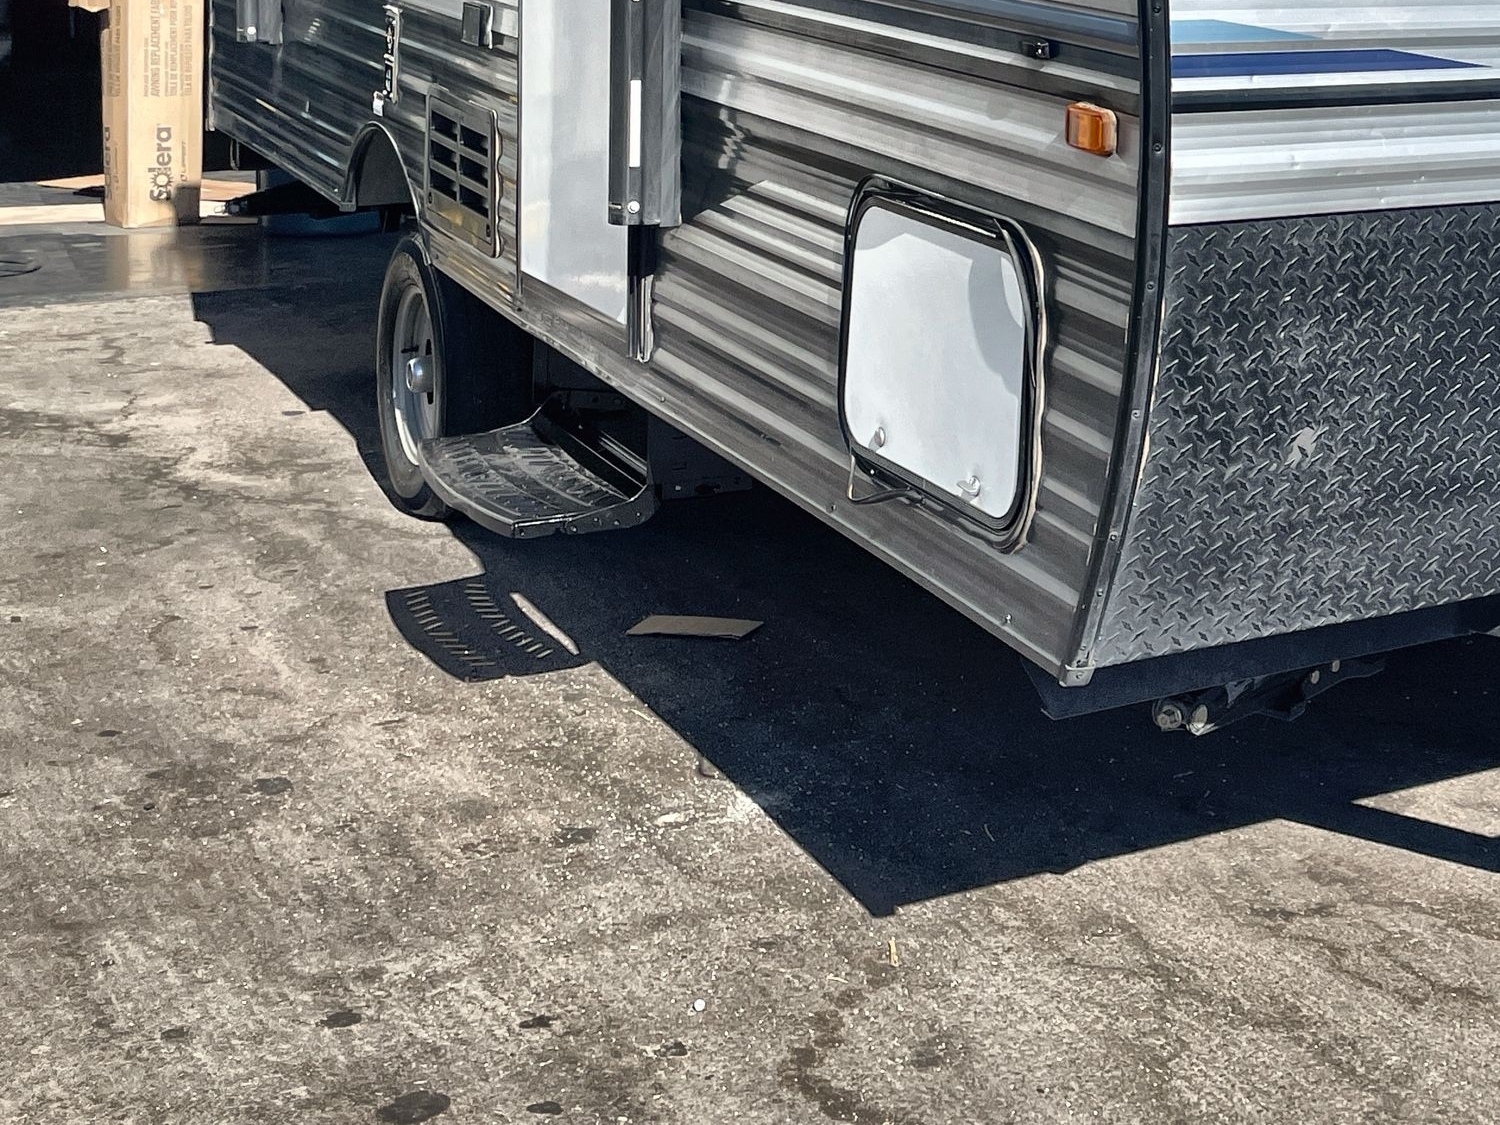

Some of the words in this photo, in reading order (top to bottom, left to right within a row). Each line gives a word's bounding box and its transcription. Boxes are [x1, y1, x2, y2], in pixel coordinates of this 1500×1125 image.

[150, 15, 160, 66] REPLACEMENT
[150, 67, 160, 97] AWNING
[148, 127, 173, 202] Solera
